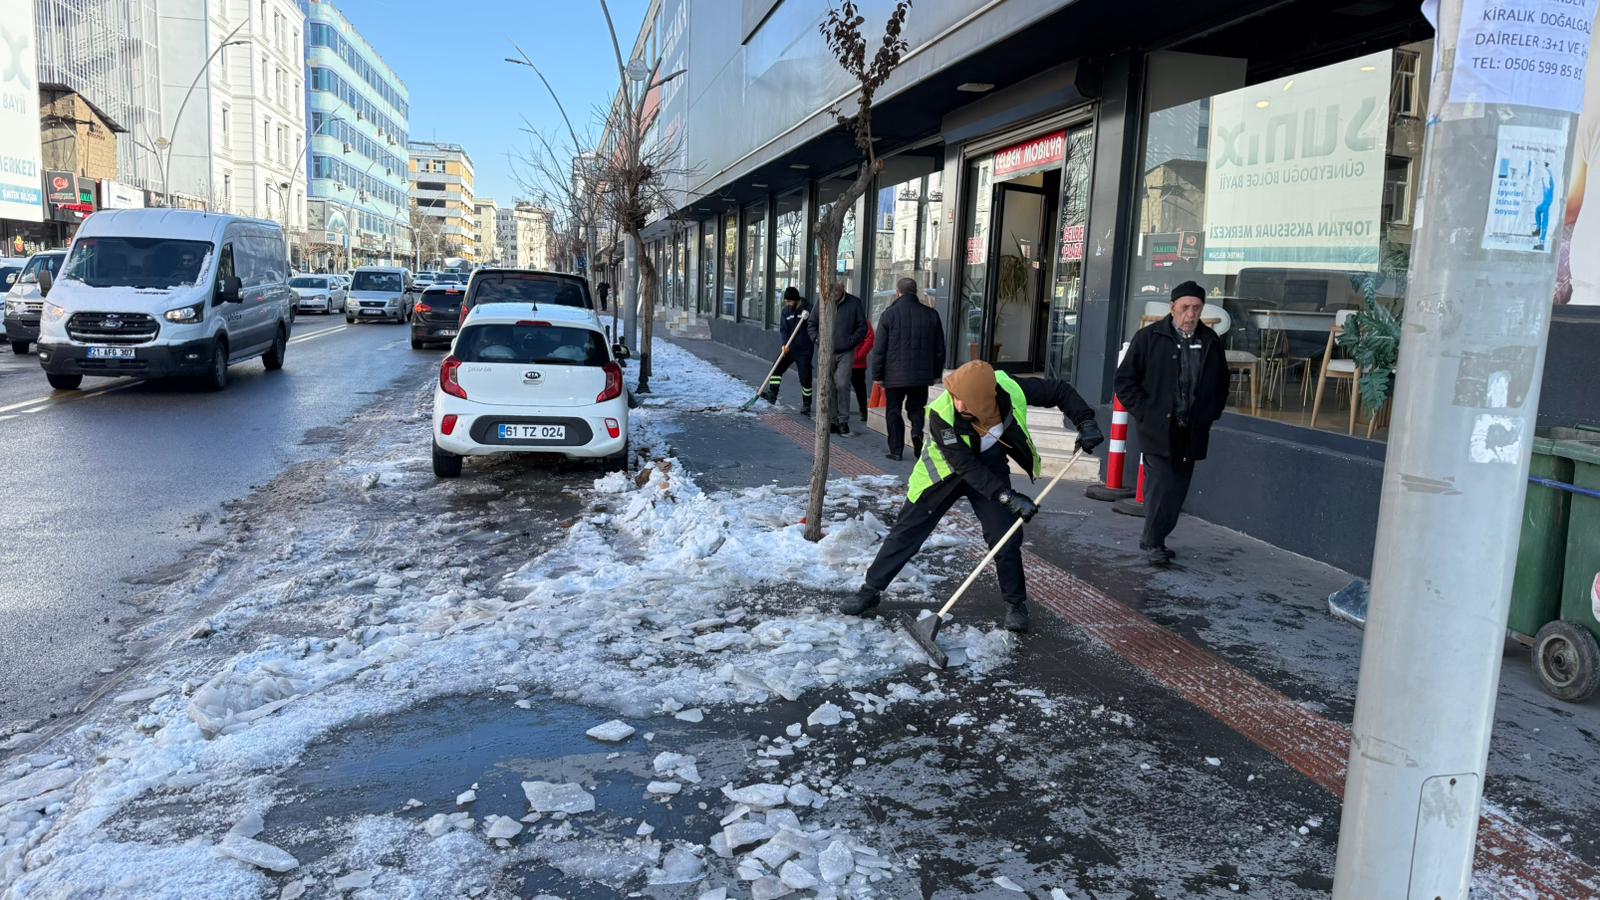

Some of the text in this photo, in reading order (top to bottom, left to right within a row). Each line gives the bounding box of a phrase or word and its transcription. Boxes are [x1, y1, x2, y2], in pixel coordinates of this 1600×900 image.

[1483, 7, 1535, 23] KİRALIK
[1475, 31, 1539, 48] DAİRELER
[1567, 40, 1580, 54] VE
[1472, 57, 1500, 69] TEL:
[1505, 57, 1535, 72] 0506
[1538, 61, 1558, 75] 599
[1560, 64, 1572, 77] 85
[1023, 136, 1062, 164] MOBİLYA
[505, 426, 564, 438] 61 TZ 024
